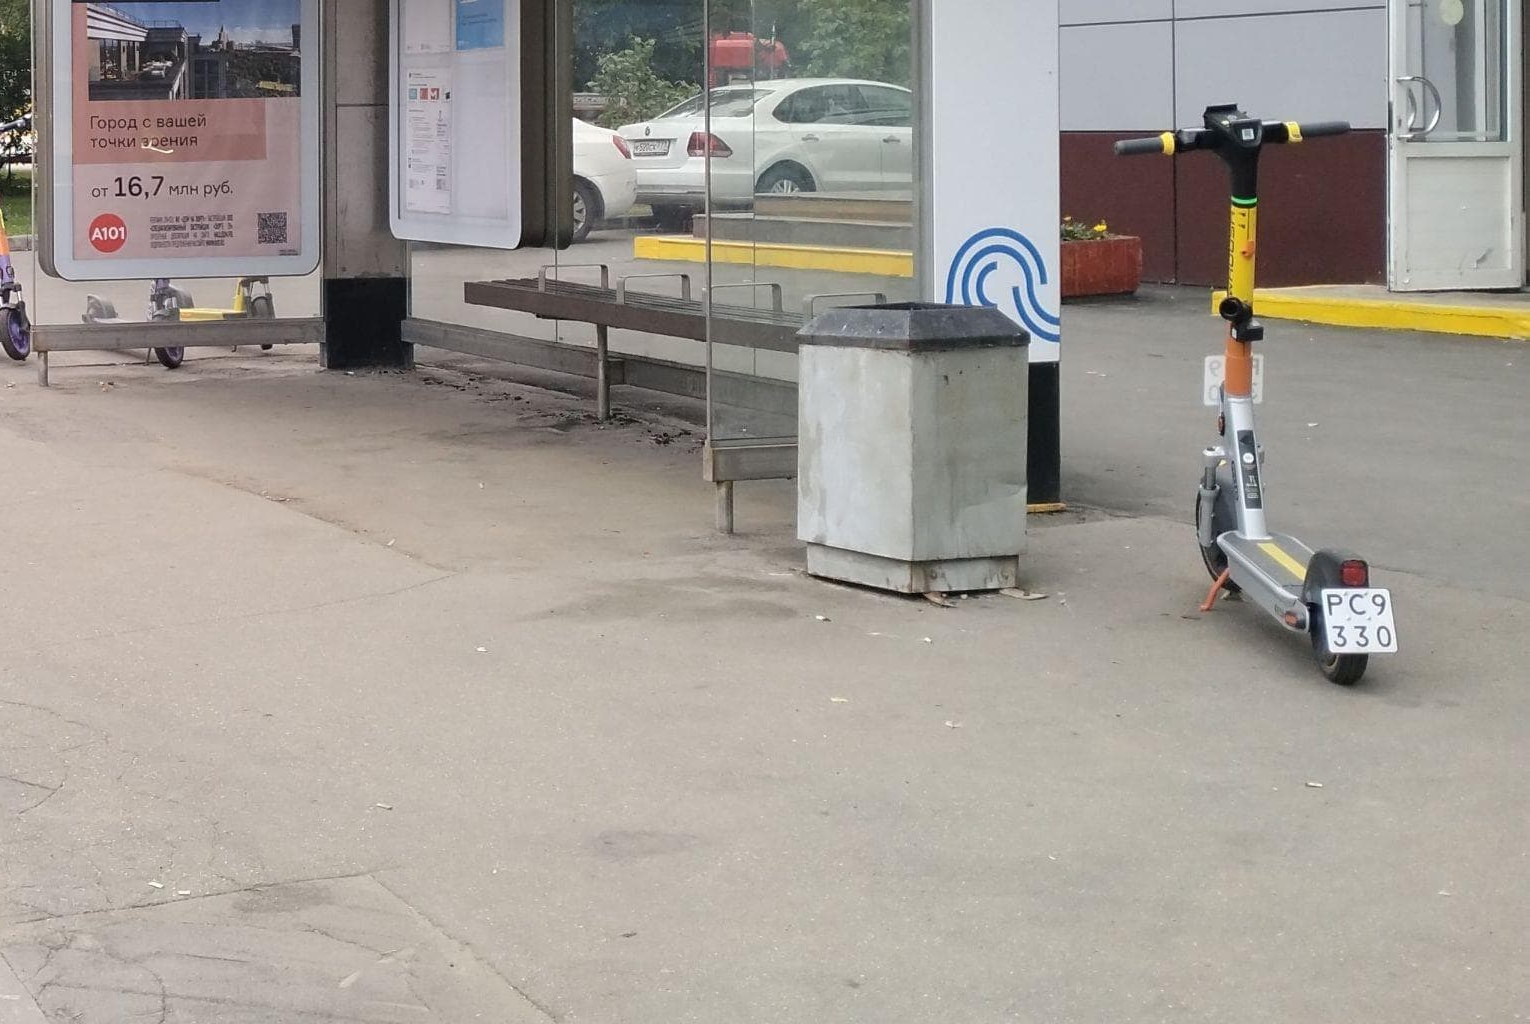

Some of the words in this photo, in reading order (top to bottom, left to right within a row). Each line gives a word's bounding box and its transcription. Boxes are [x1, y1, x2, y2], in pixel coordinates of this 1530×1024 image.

[90, 116, 138, 132] Город
[142, 118, 152, 128] с
[156, 114, 207, 128] вашей
[91, 138, 136, 148] точки
[141, 135, 198, 150] зрения
[91, 187, 109, 198] от
[114, 176, 164, 199] 16,7
[169, 184, 199, 195] млн
[203, 180, 233, 198] руб.
[91, 227, 125, 241] А101
[1327, 593, 1386, 616] РС9
[1332, 625, 1391, 648] 330
